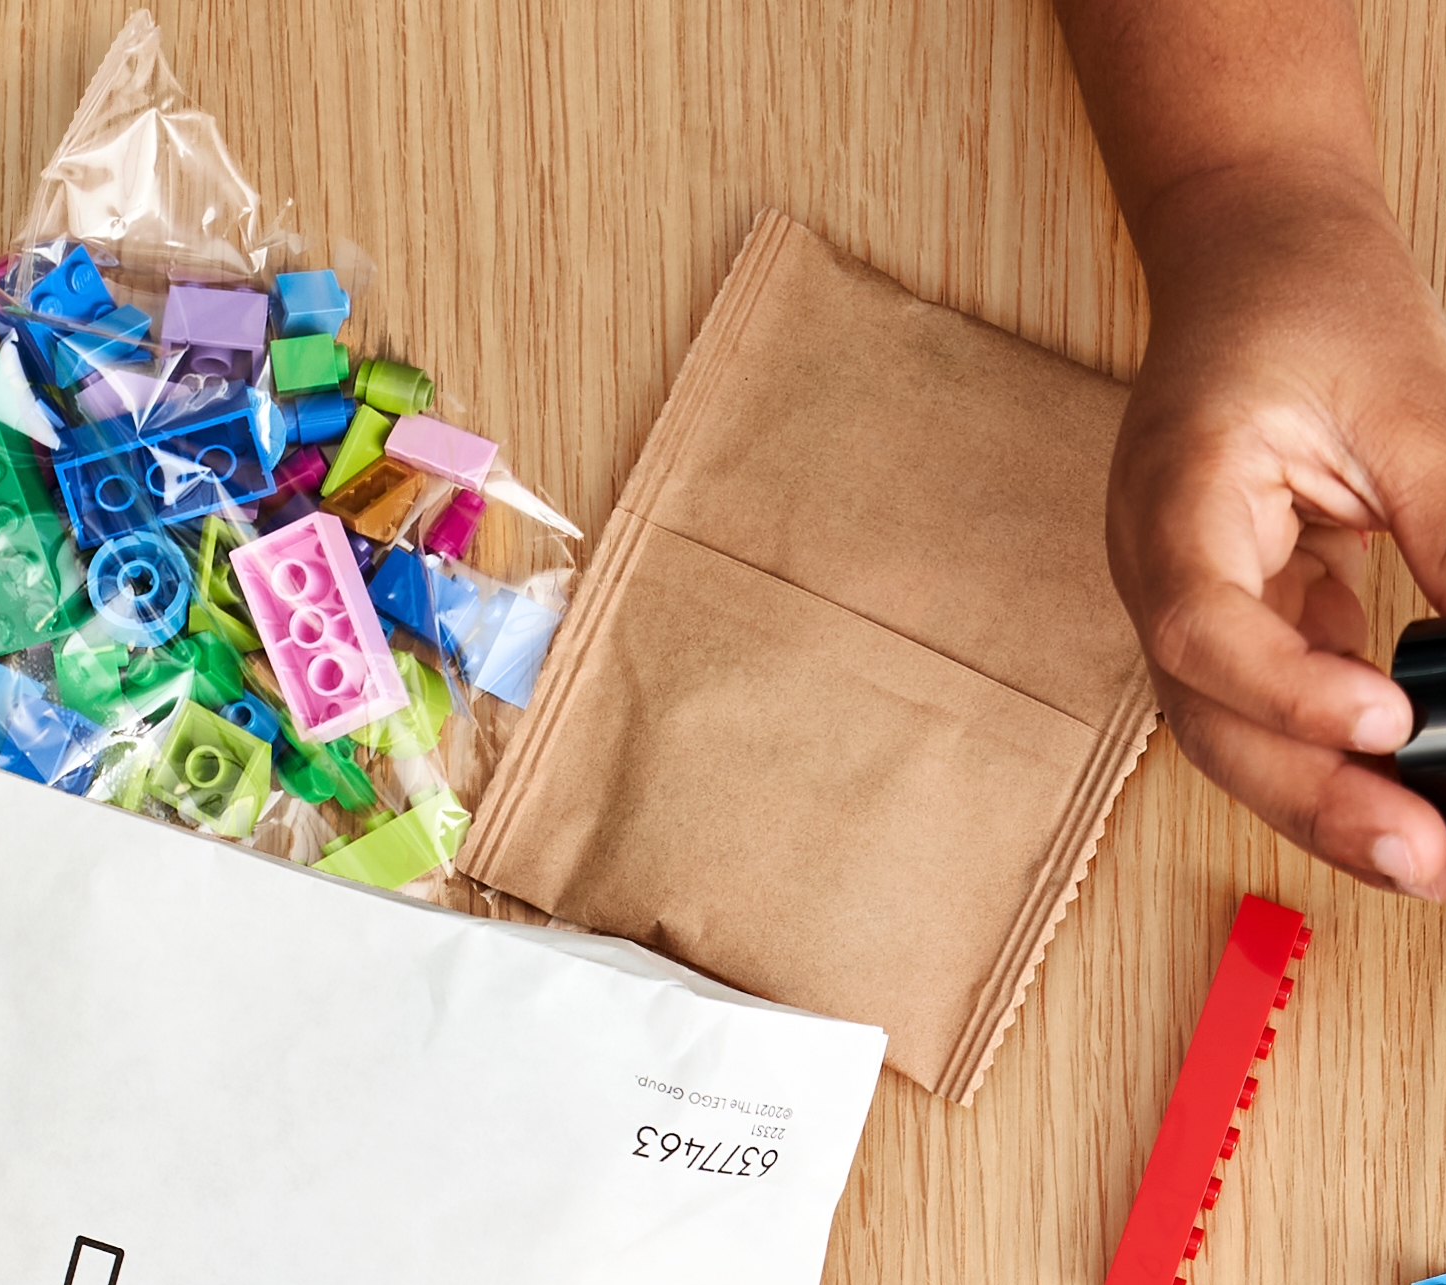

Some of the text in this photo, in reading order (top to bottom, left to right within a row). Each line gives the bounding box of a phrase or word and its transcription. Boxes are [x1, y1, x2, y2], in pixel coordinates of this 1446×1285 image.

[632, 1075, 685, 1101] Group.
[687, 1091, 726, 1110] LEGO
[728, 1097, 752, 1114] The
[632, 1125, 779, 1178] 6377463
